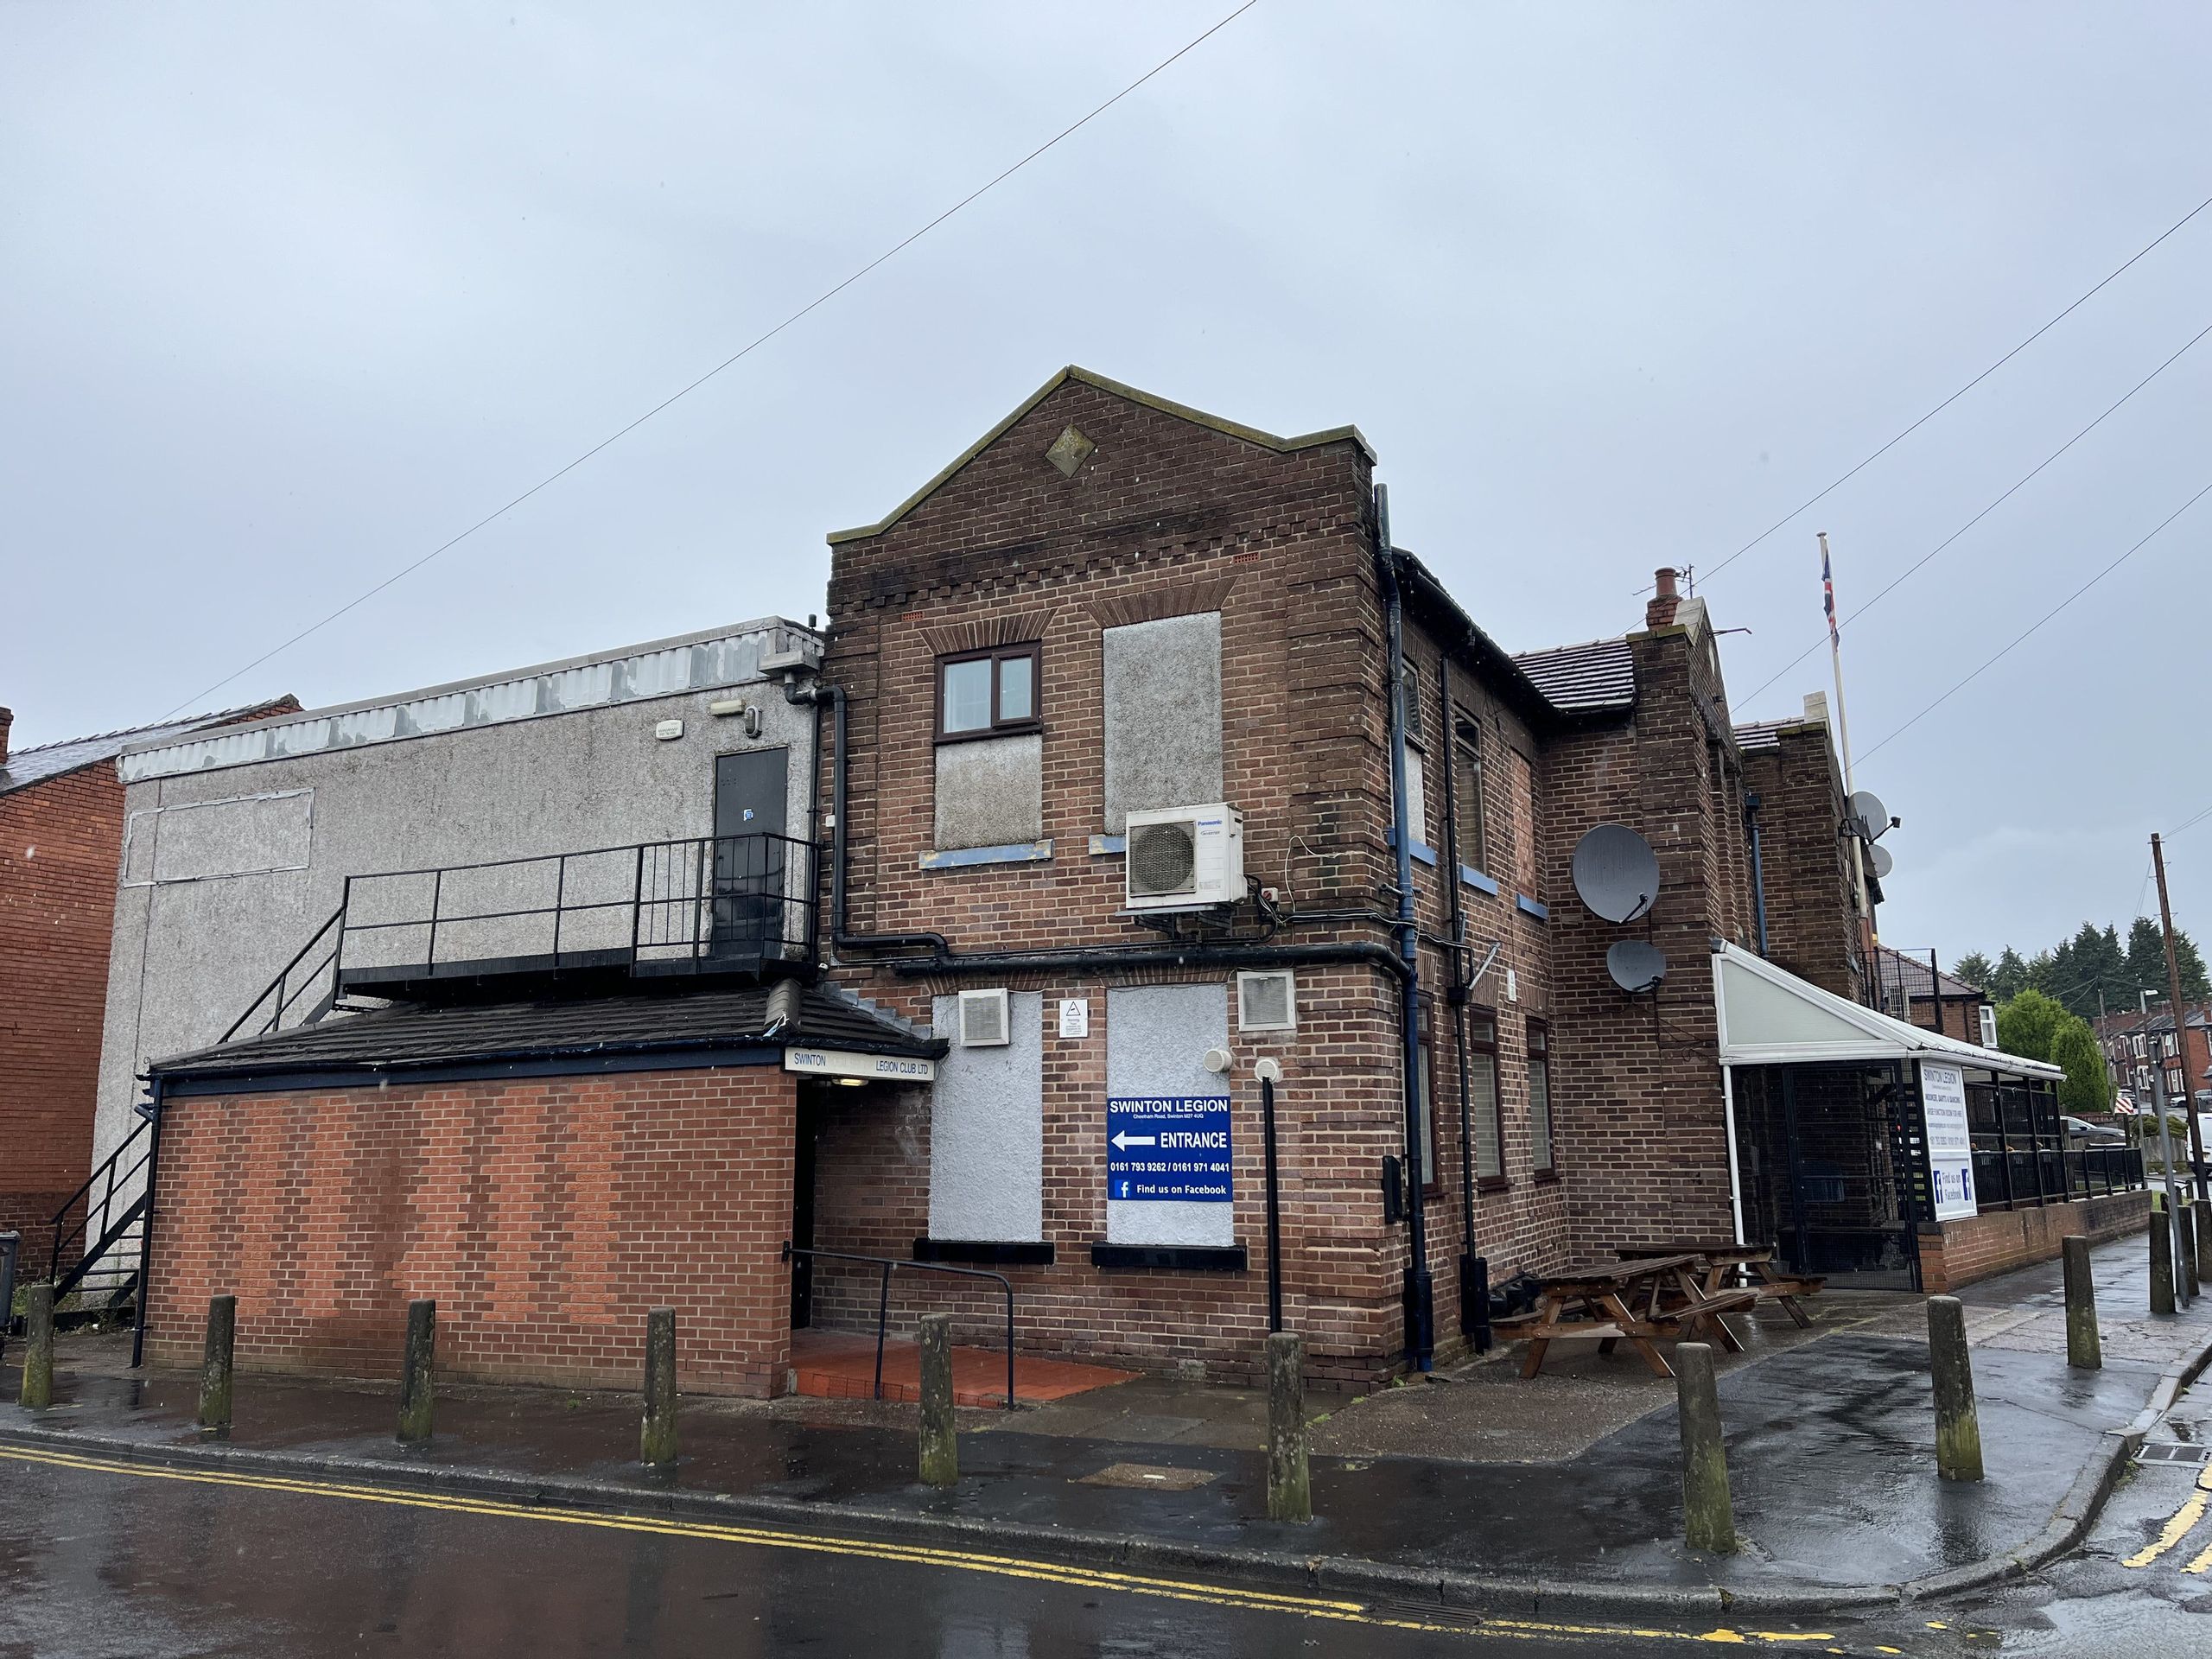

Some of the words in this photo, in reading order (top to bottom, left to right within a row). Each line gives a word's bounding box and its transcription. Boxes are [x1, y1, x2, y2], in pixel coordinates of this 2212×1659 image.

[794, 1052, 826, 1066] SWINTON
[875, 1060, 899, 1072] LEGION
[899, 1062, 916, 1073] CLUB
[918, 1064, 928, 1075] LTD
[1923, 1069, 1942, 1083] SWINTON
[1109, 1100, 1172, 1113] SWINTON
[1176, 1099, 1228, 1112] LEGION
[1160, 1132, 1228, 1148] ENTRANCE
[1110, 1162, 1128, 1172] 0161
[1131, 1162, 1146, 1172] 793
[1147, 1162, 1166, 1172] 9262
[1167, 1162, 1171, 1172] /
[1173, 1162, 1192, 1172] 0161
[1193, 1163, 1208, 1172] 971
[1210, 1163, 1230, 1172] 4041
[1136, 1185, 1155, 1194] Find
[1185, 1185, 1227, 1195] Facebook
